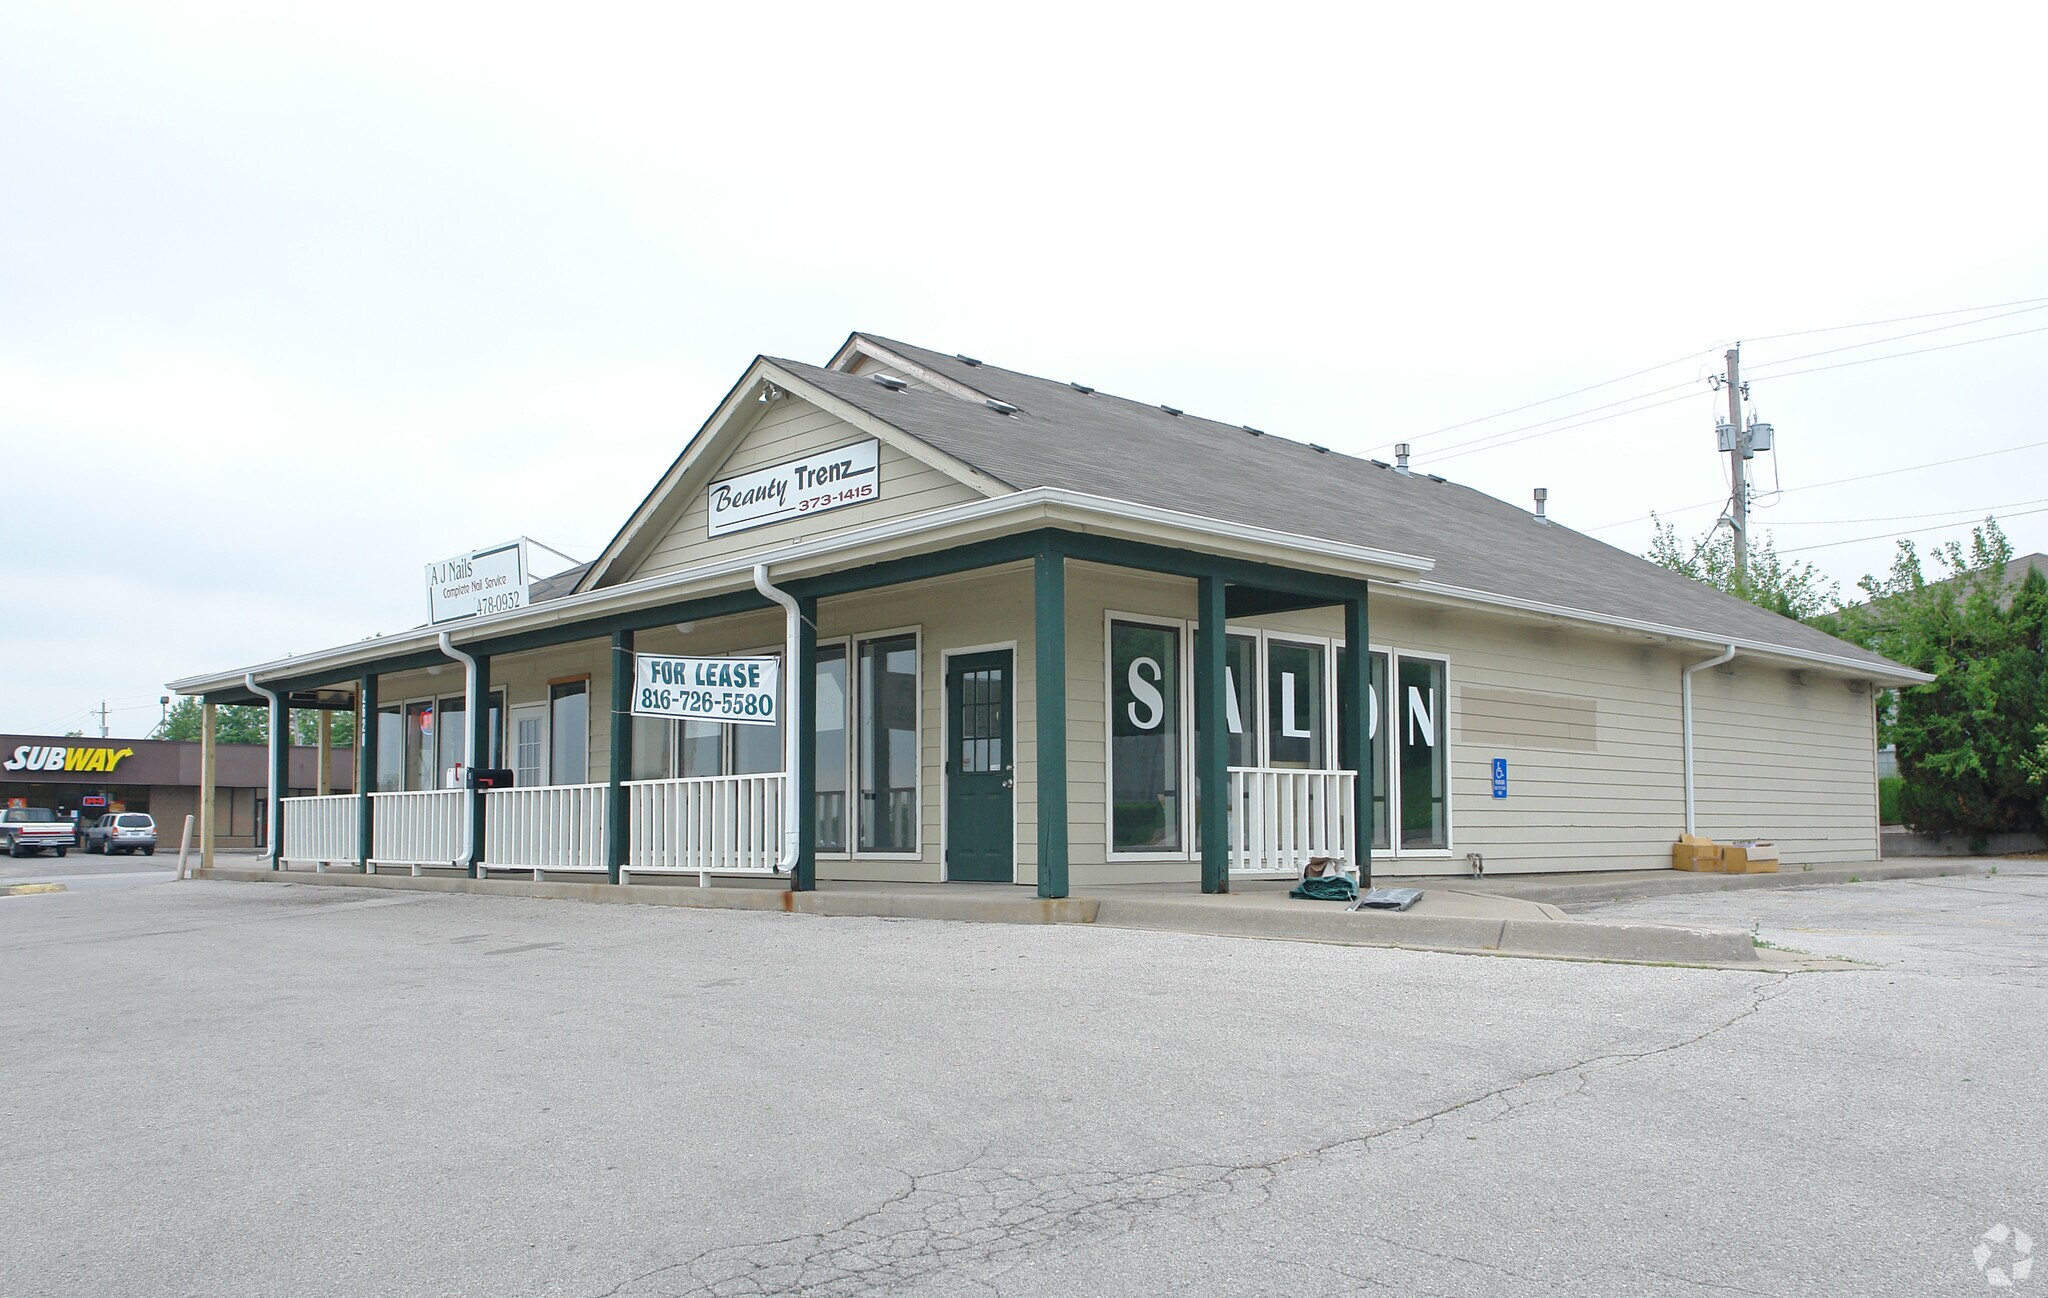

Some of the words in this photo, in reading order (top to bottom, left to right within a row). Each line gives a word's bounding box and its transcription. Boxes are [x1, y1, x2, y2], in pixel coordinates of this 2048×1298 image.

[711, 478, 788, 512] Beauty
[795, 460, 876, 490] Trenz
[799, 484, 873, 512] 373-1415
[431, 566, 438, 586] A
[440, 564, 446, 583] J
[449, 558, 473, 581] Nails
[443, 584, 470, 599] Complete
[471, 579, 483, 592] Nail
[485, 575, 507, 590] Service
[477, 591, 520, 616] 478-0932
[651, 661, 686, 685] FOR
[696, 663, 760, 688] LEASE
[642, 688, 773, 716] 816-726-5580
[3, 746, 134, 772] SUBWAY
